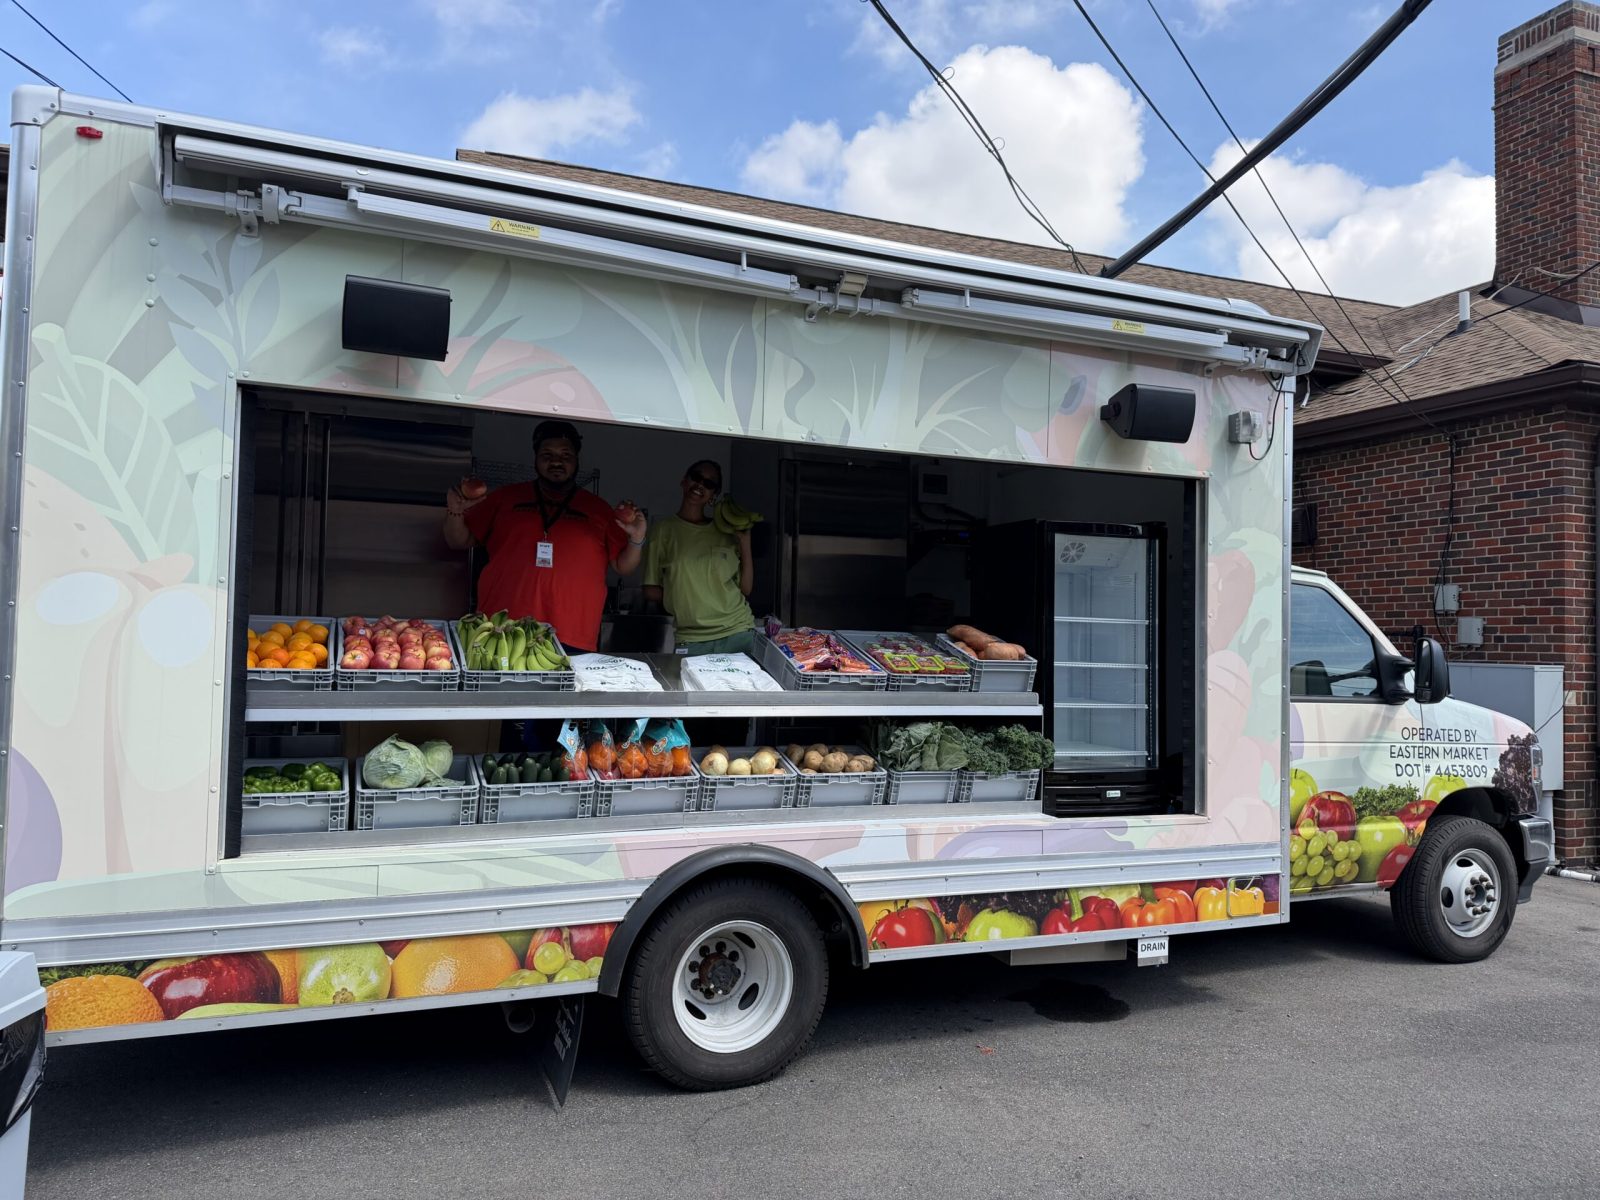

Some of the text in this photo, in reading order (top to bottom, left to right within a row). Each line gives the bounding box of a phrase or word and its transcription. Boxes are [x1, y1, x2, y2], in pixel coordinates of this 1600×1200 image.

[508, 222, 535, 231] WARNING
[1401, 727, 1477, 742] OPERATED BY
[1390, 745, 1488, 760] EASTERN MARKET
[1395, 763, 1488, 778] DOT # 4453809
[1140, 942, 1166, 952] DRAIN
